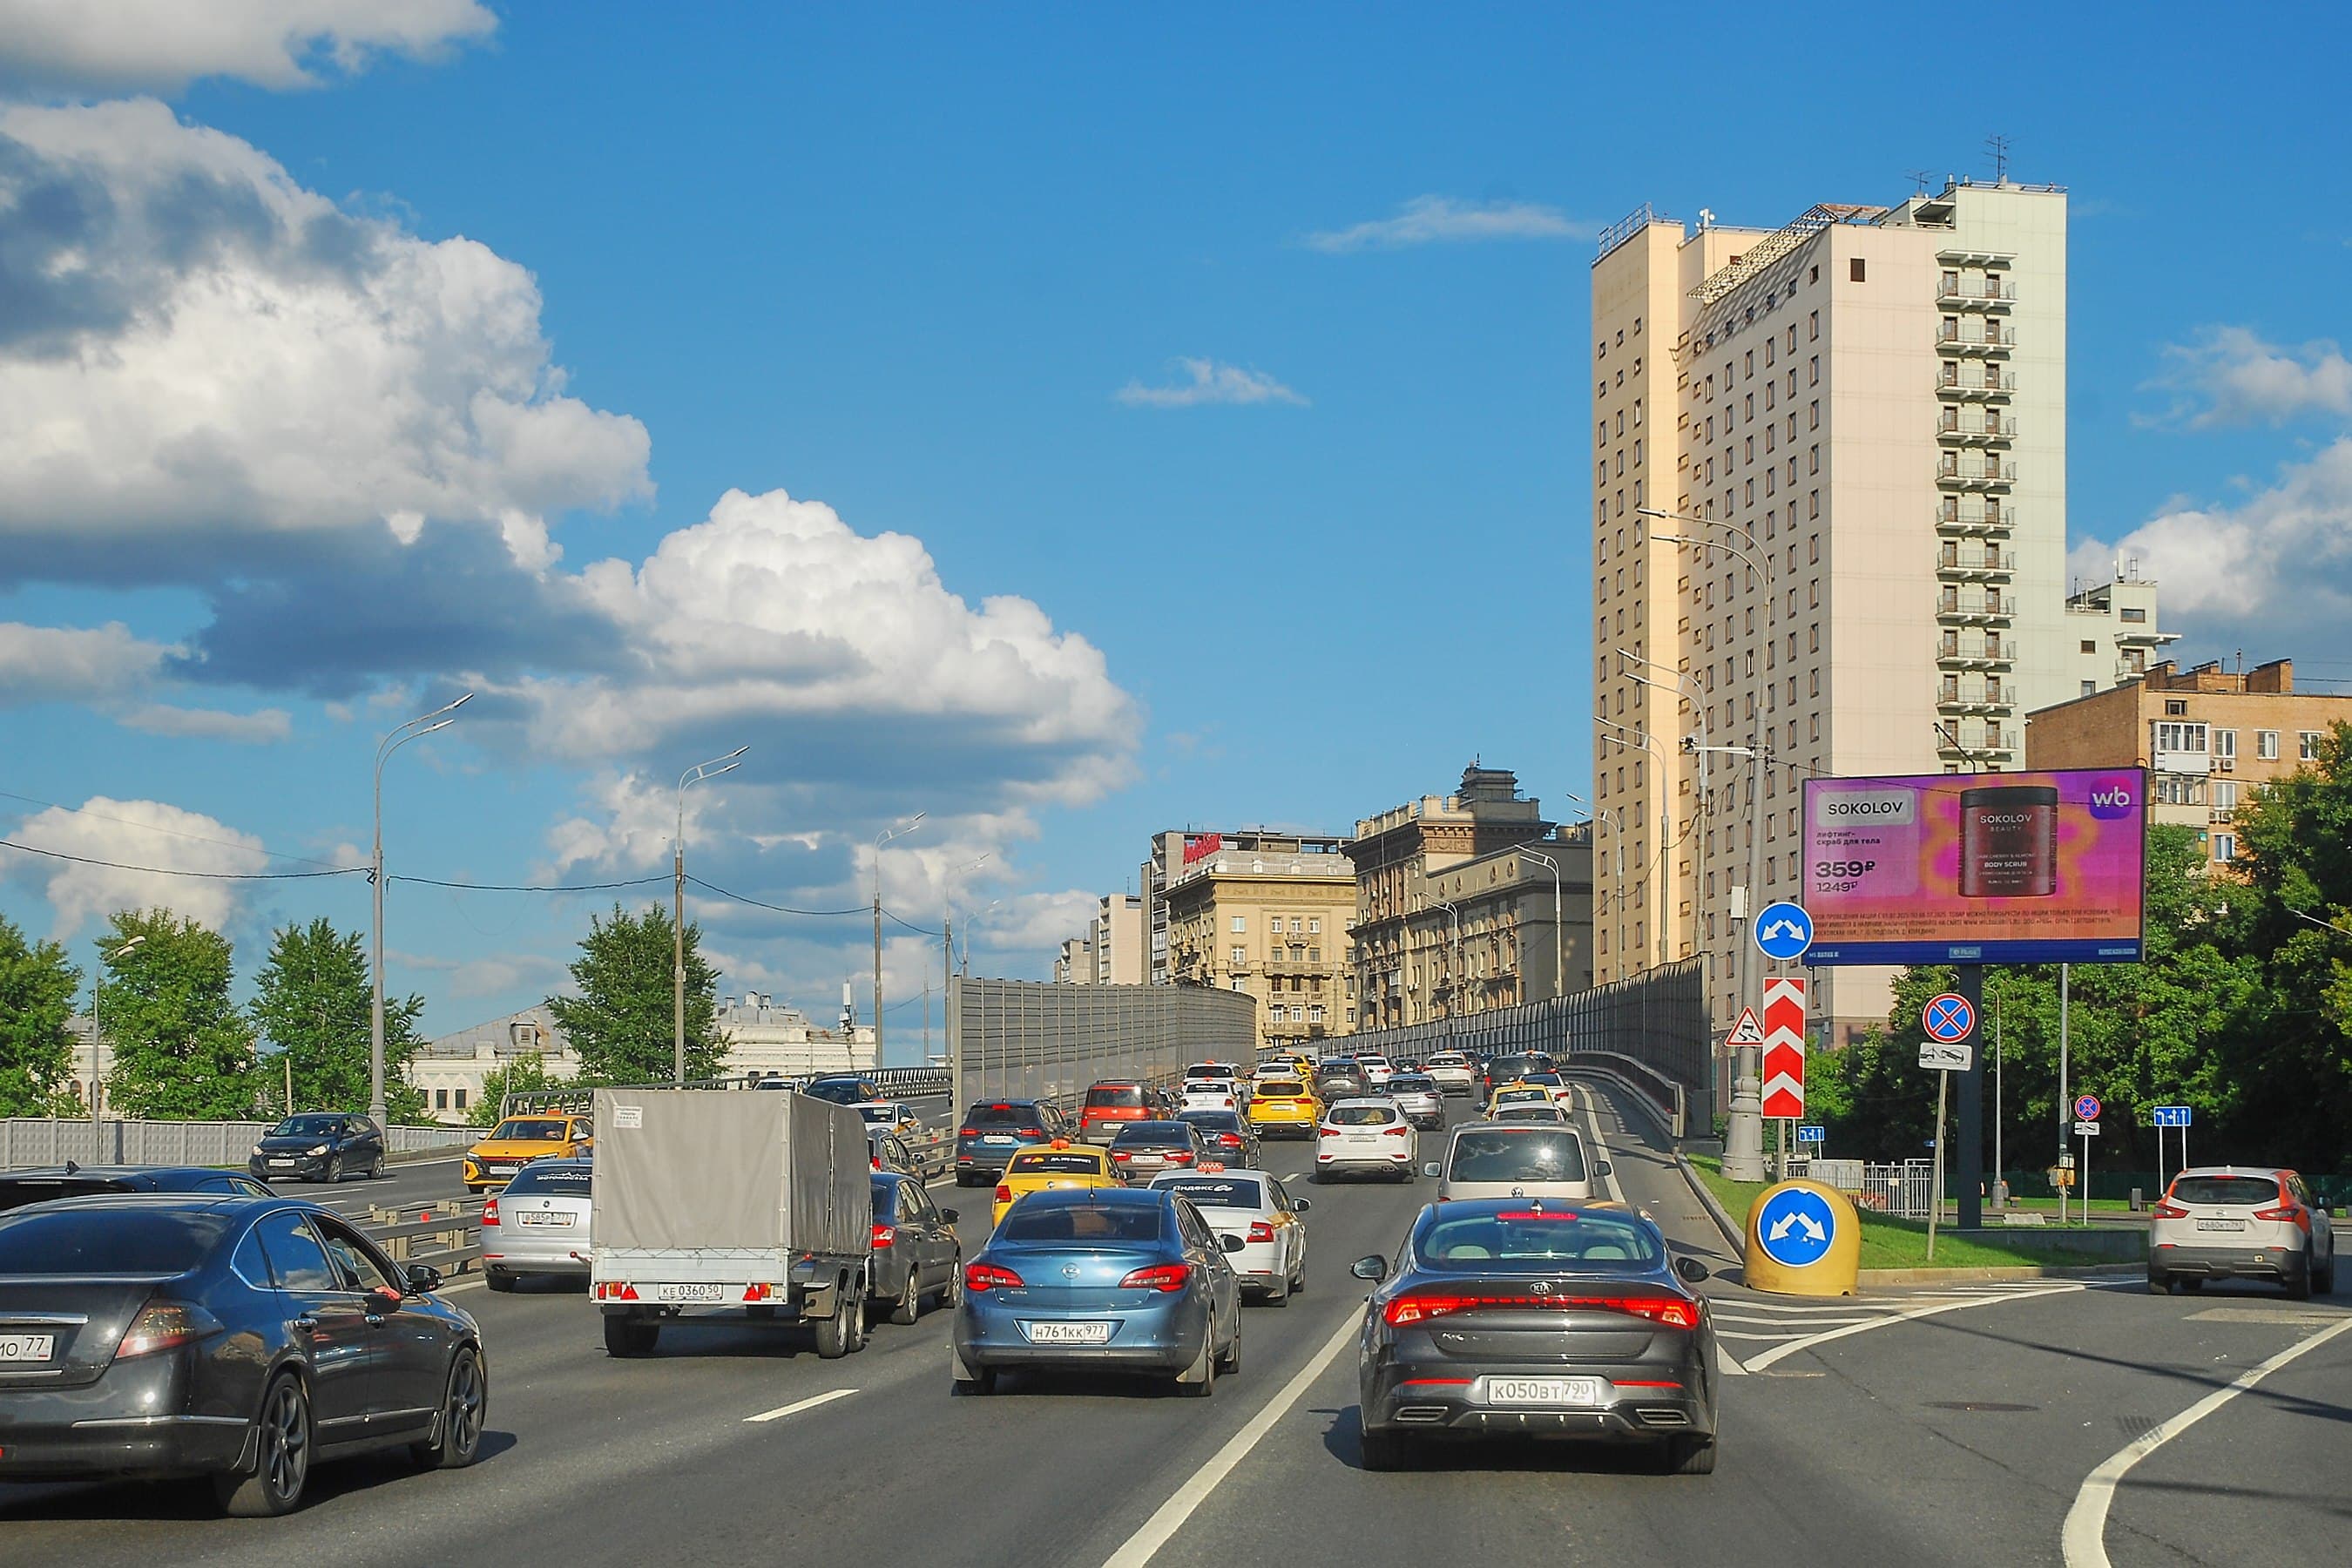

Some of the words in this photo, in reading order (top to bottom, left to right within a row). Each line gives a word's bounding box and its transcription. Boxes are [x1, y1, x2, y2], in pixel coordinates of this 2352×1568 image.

[2092, 786, 2130, 808] wb
[1828, 801, 1903, 815] SOKOLOV
[1979, 814, 2032, 824] SOKOLOV
[1816, 838, 1842, 847] скраб
[679, 1285, 706, 1296] 0360
[707, 1285, 719, 1294] 50
[1531, 1283, 1551, 1294] KIA
[1035, 1326, 1083, 1338] Н761КК
[1085, 1325, 1105, 1335] 977
[26, 1337, 45, 1352] 77
[1495, 1382, 1561, 1400] К050ВТ
[1563, 1382, 1589, 1395] 790
